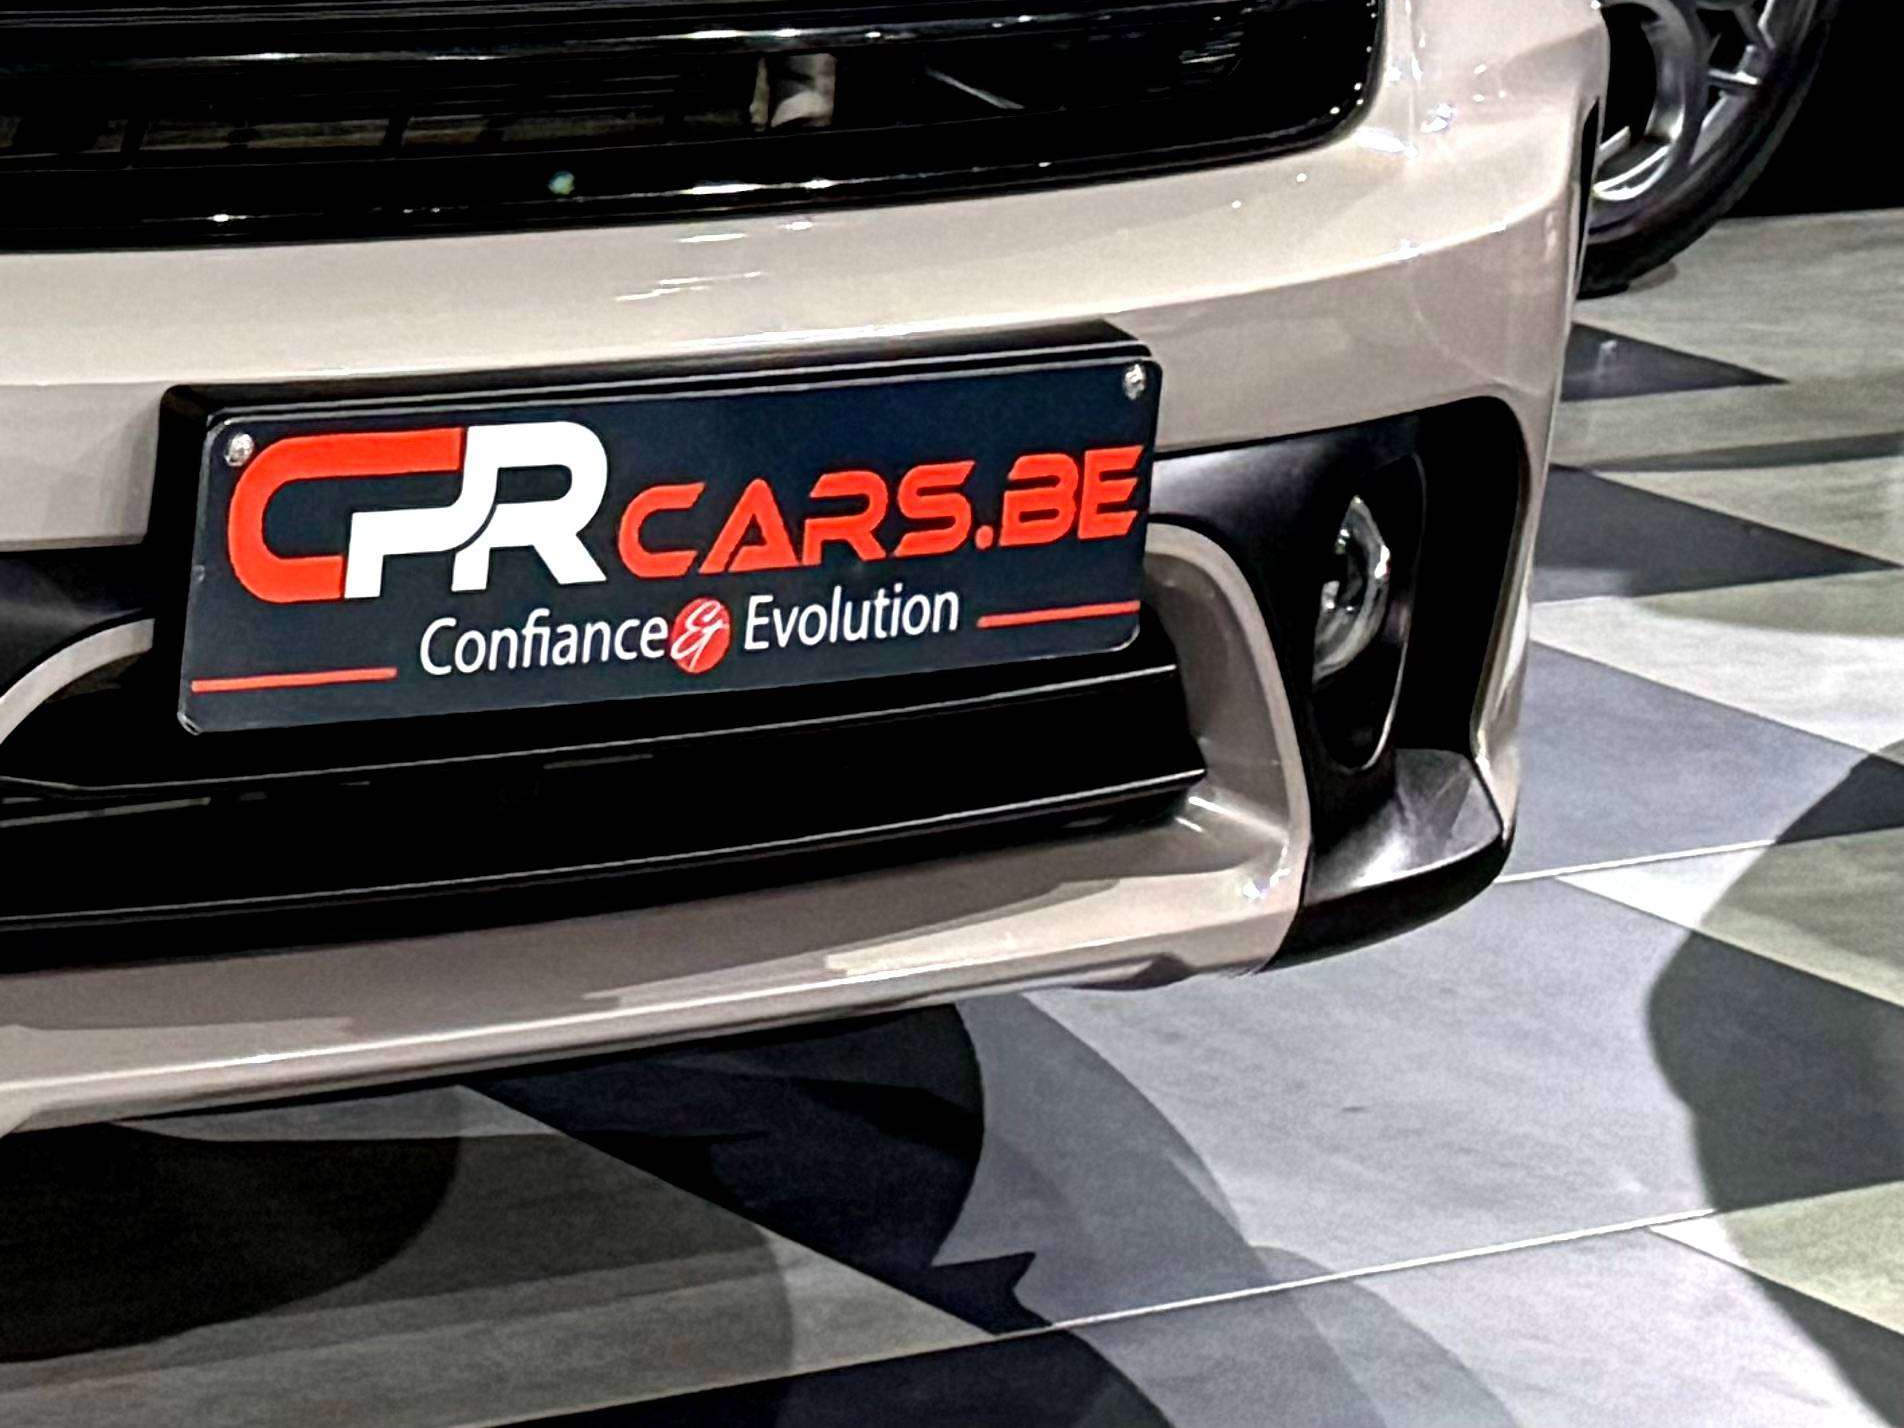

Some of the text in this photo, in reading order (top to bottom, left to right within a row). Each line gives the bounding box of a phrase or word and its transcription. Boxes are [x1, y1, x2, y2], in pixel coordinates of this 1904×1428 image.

[618, 445, 1143, 579] CARS.BE
[419, 608, 669, 676] Confiance
[743, 582, 960, 652] Evolution
